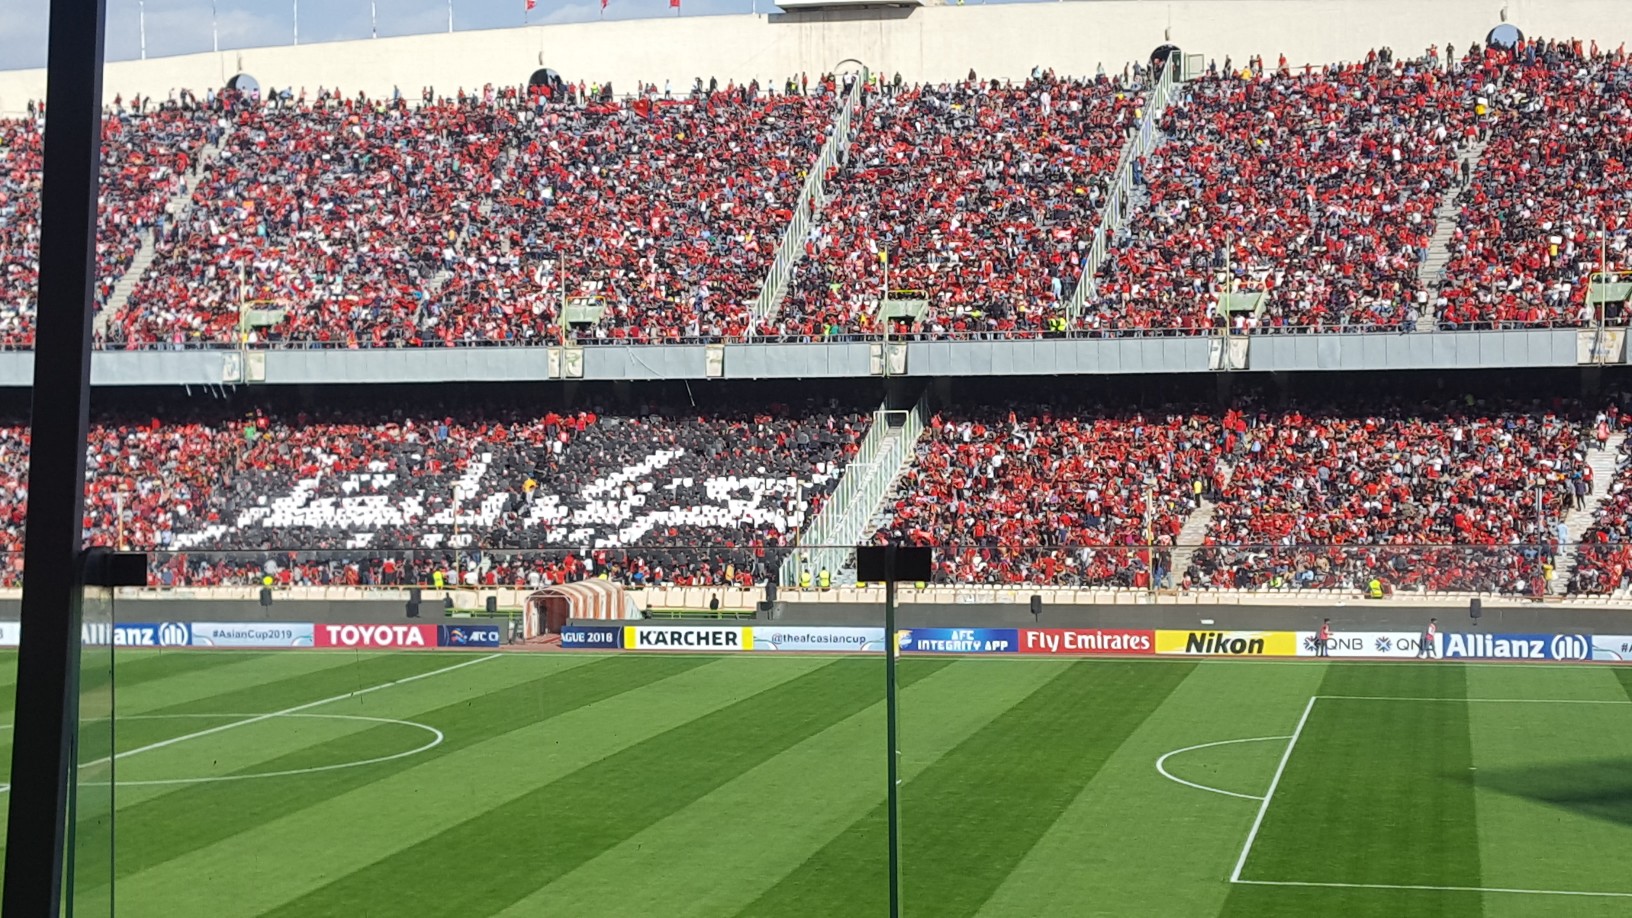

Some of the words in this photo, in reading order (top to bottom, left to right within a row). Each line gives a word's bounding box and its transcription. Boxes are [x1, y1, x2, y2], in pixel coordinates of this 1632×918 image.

[212, 629, 292, 640] #AsianCup2019
[326, 624, 425, 646] TOYOTA
[587, 632, 613, 643] 2018
[640, 630, 738, 646] KÄRCHER
[771, 633, 866, 645] @theafcasiancup
[951, 630, 975, 641] AFC
[917, 640, 981, 651] INTEGRITY
[984, 640, 1009, 651] APP
[1026, 631, 1060, 652] Fly
[1063, 631, 1151, 650] Emirates
[1185, 632, 1265, 654] Nikon
[1326, 637, 1364, 650] QNB
[1396, 638, 1423, 651] QN
[1445, 633, 1545, 658] Allianz
